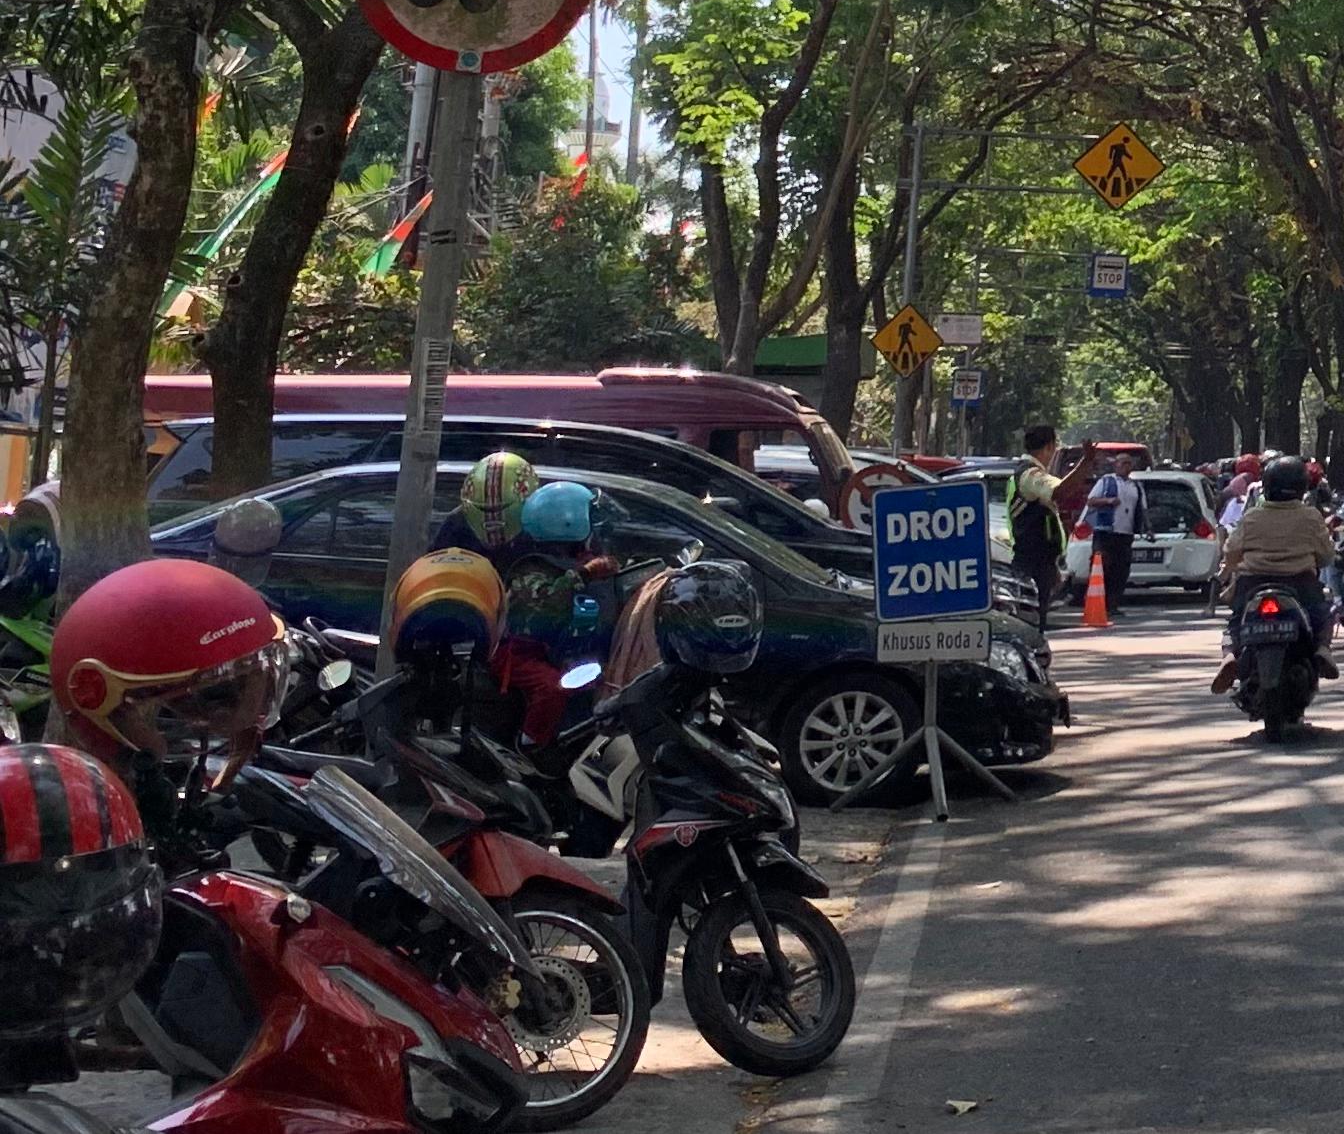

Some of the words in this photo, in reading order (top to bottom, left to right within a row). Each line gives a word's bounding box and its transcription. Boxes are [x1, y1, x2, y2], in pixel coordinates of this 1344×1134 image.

[1097, 273, 1122, 283] STOP
[956, 385, 977, 395] STOP
[886, 506, 976, 544] DROP
[887, 558, 979, 596] ZONE
[882, 631, 931, 651] Khusus
[936, 630, 971, 649] Roda
[976, 630, 985, 648] 2
